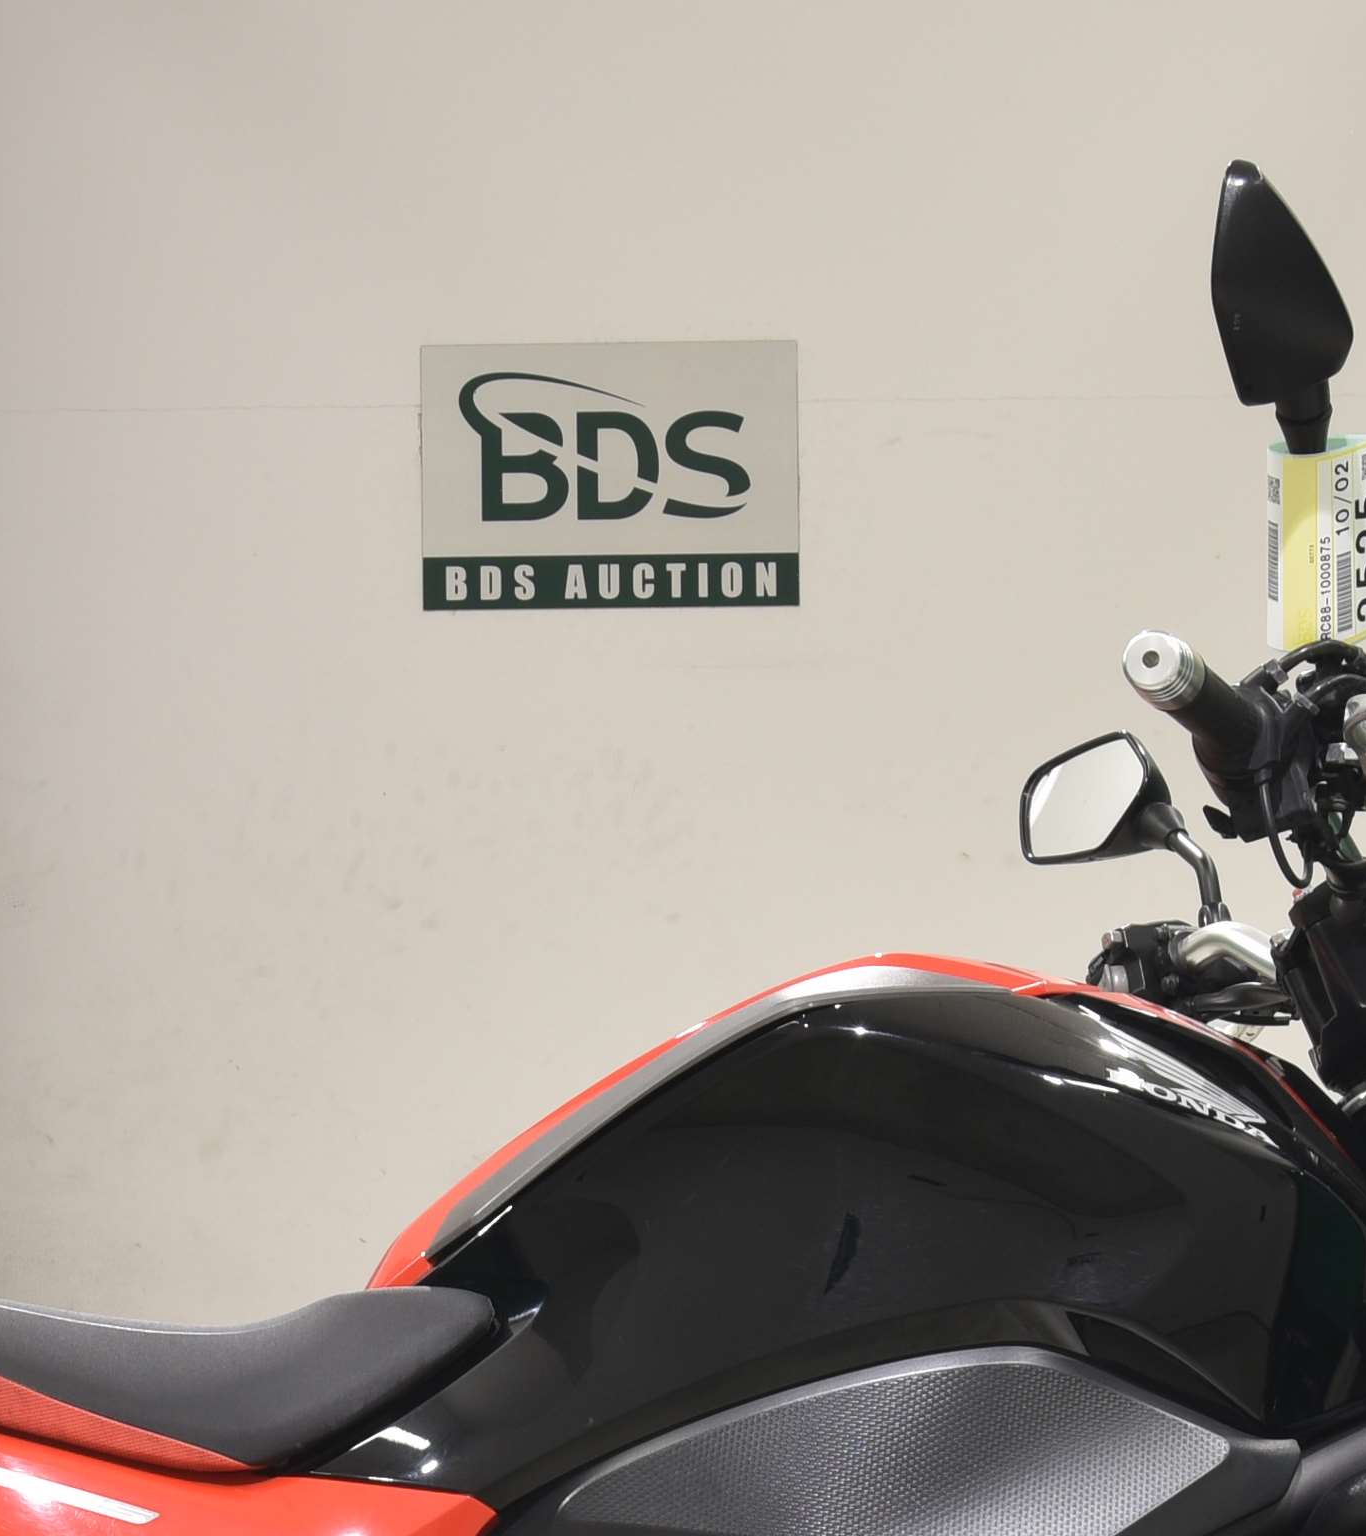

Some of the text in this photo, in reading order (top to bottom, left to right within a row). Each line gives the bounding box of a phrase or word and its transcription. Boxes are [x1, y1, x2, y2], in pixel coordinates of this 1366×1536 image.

[459, 372, 751, 522] BDS
[1334, 461, 1352, 535] 10/02
[445, 562, 778, 601] BDS AUCTION
